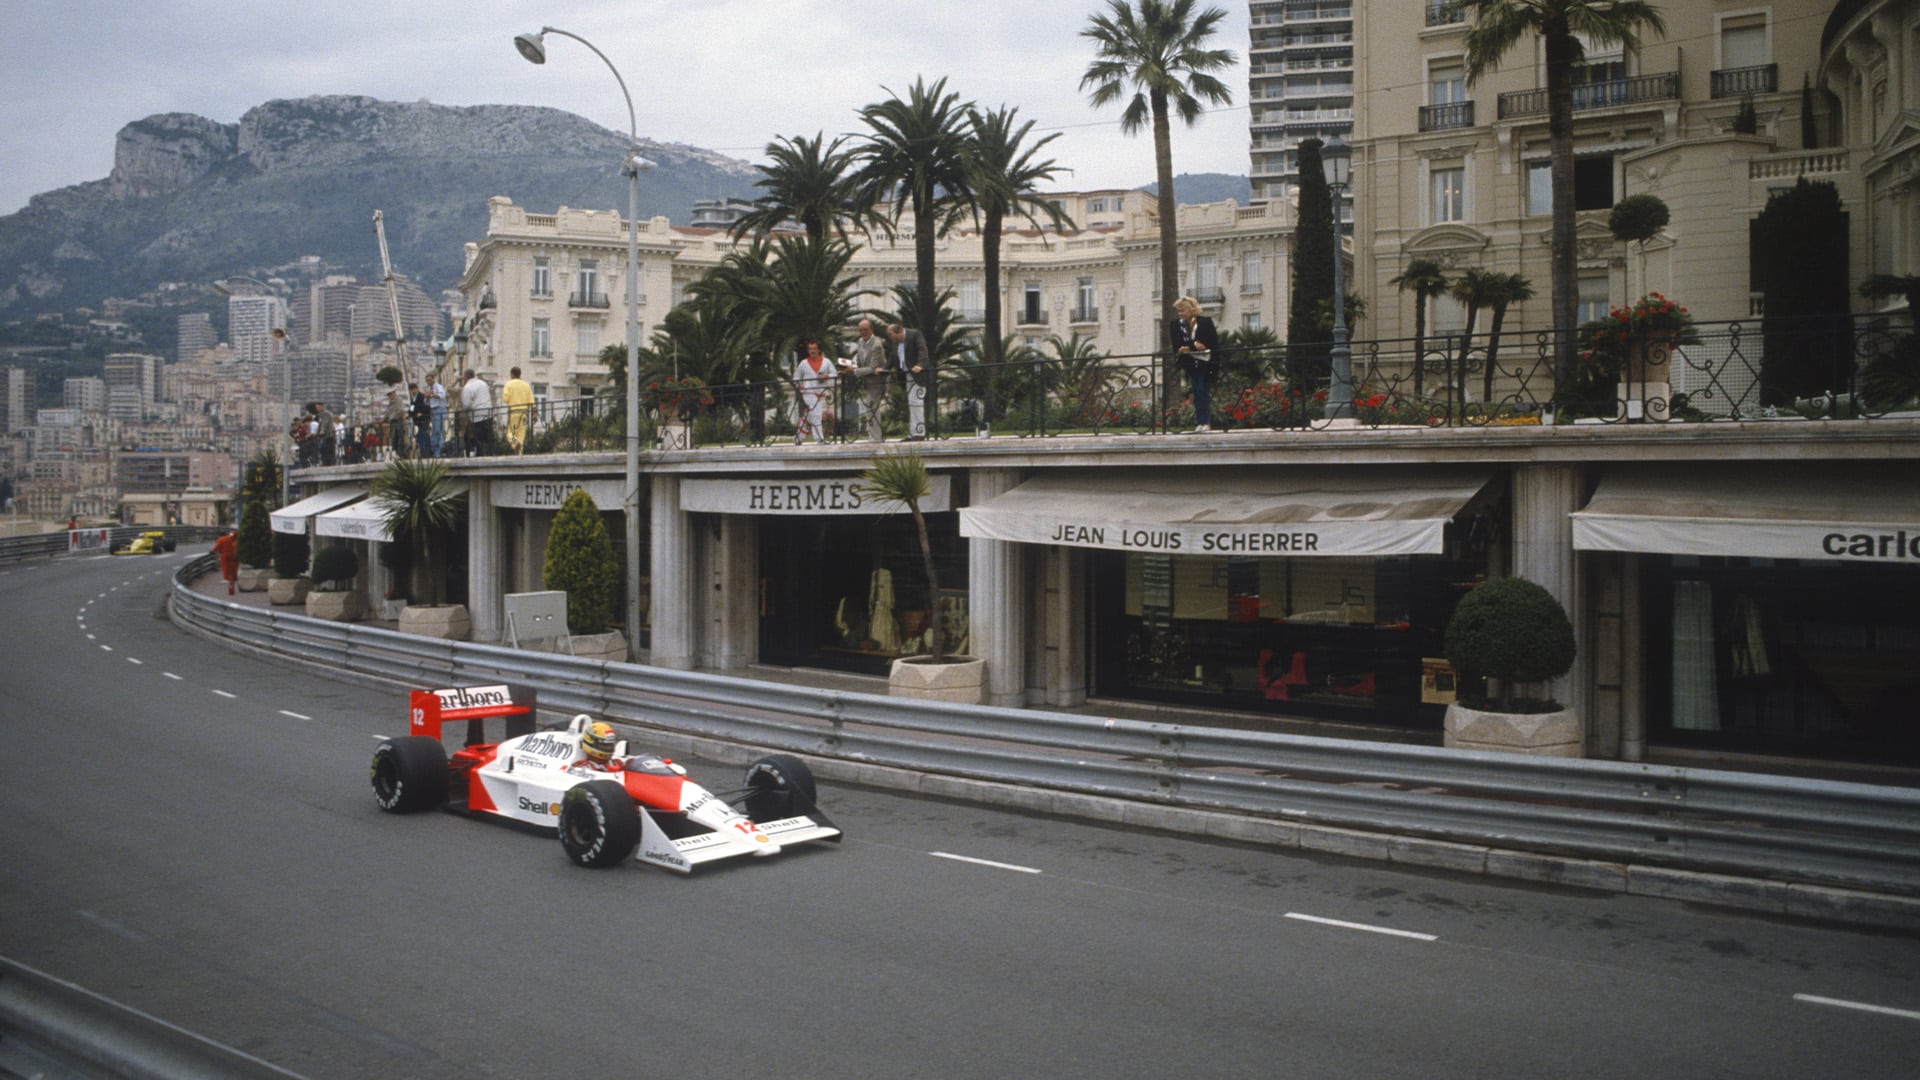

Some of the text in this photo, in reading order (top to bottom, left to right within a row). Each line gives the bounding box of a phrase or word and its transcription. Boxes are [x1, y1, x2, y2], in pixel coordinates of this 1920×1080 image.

[1052, 525, 1319, 550] JEAN LOUIS SCHERRER
[440, 687, 504, 709] arlboro
[413, 708, 424, 726] 12
[515, 734, 573, 760] Marlboro
[519, 796, 548, 815] Shell
[734, 821, 761, 834] 12
[761, 818, 800, 831] Shell
